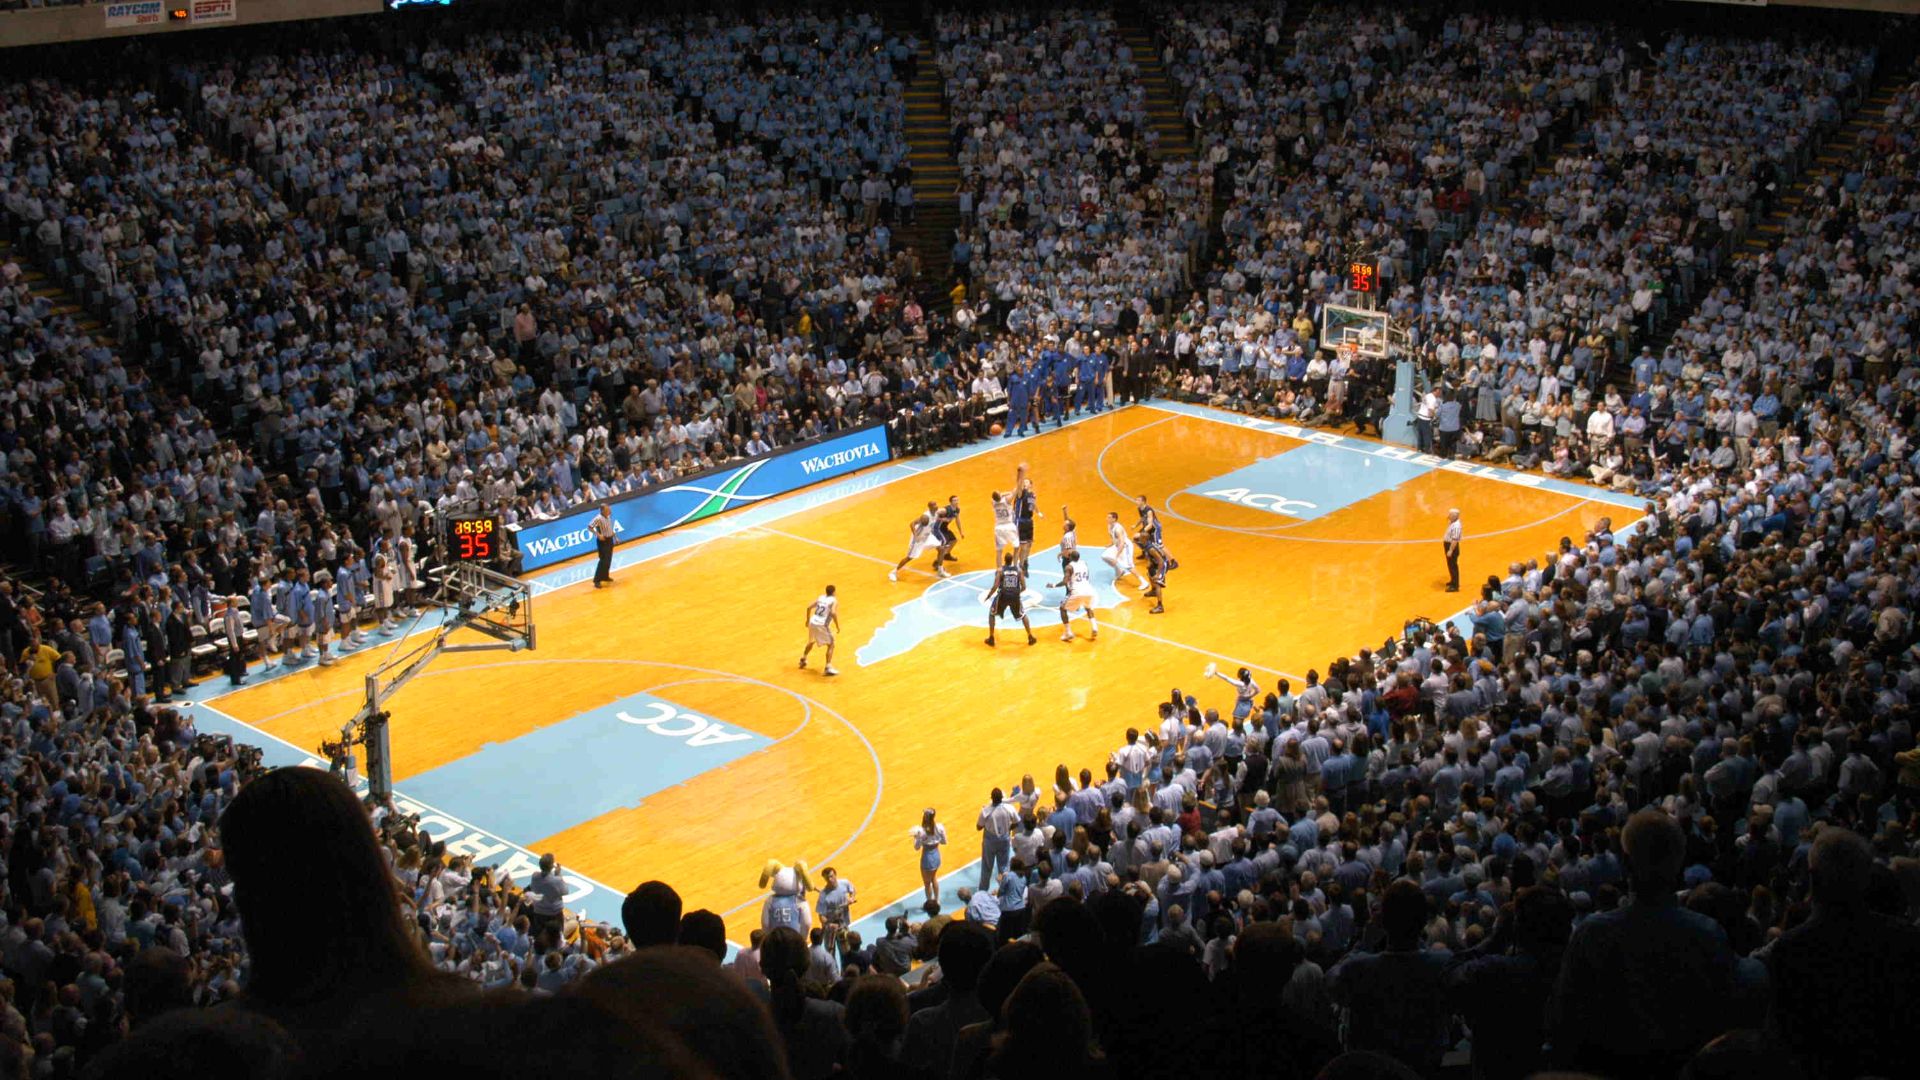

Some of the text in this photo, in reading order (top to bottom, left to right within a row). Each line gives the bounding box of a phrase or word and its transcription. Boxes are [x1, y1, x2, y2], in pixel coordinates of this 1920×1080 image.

[107, 2, 160, 17] RAYCOM
[195, 0, 232, 13] ESPN
[1352, 273, 1369, 291] 35
[800, 442, 880, 475] WACHOVIA
[1242, 417, 1546, 487] TAR HEELS
[1202, 488, 1317, 514] ACC
[455, 519, 493, 534] 19:59
[524, 519, 625, 558] WACHOA
[460, 533, 489, 558] 35
[616, 702, 753, 747] ACC
